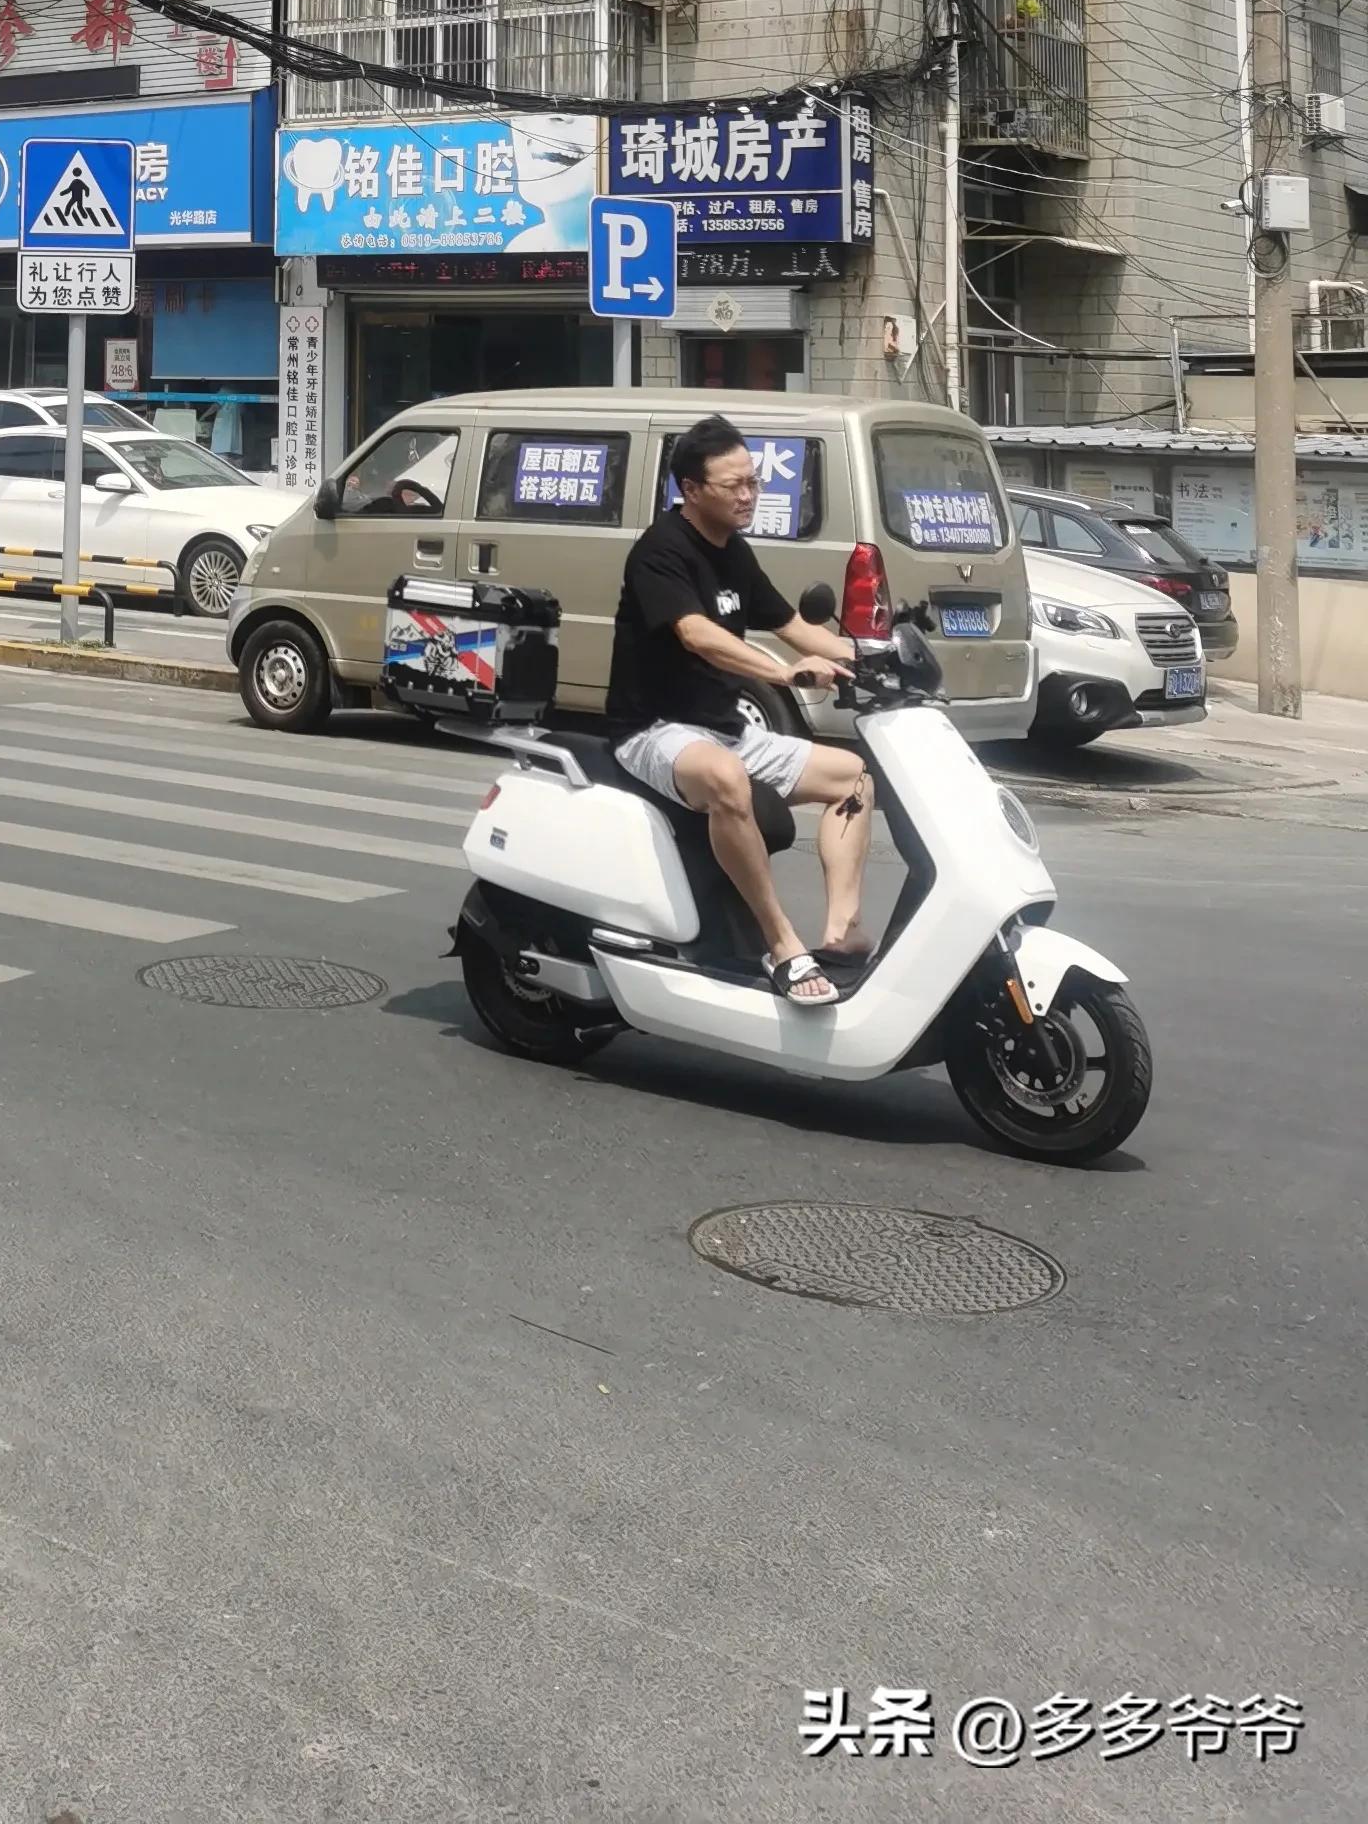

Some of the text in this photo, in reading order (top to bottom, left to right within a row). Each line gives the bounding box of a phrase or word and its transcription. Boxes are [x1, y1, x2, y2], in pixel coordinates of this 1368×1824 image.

[620, 110, 827, 184] 琦城房产
[344, 139, 516, 200] 铭佳口腔
[169, 209, 218, 227] 光华路店
[362, 199, 527, 230] 由此请上二楼
[851, 179, 872, 238] 售房
[701, 218, 785, 233] 13585337556
[601, 212, 649, 300] P
[28, 262, 122, 284] 礼让行人
[28, 285, 122, 308] 为您点赞
[285, 335, 300, 488] 常州铭佳口腔门诊部
[304, 336, 320, 489] 青少年牙齿矫正整形中心
[521, 446, 603, 474] 屋面翻瓦
[518, 474, 600, 503] 搭彩钢瓦
